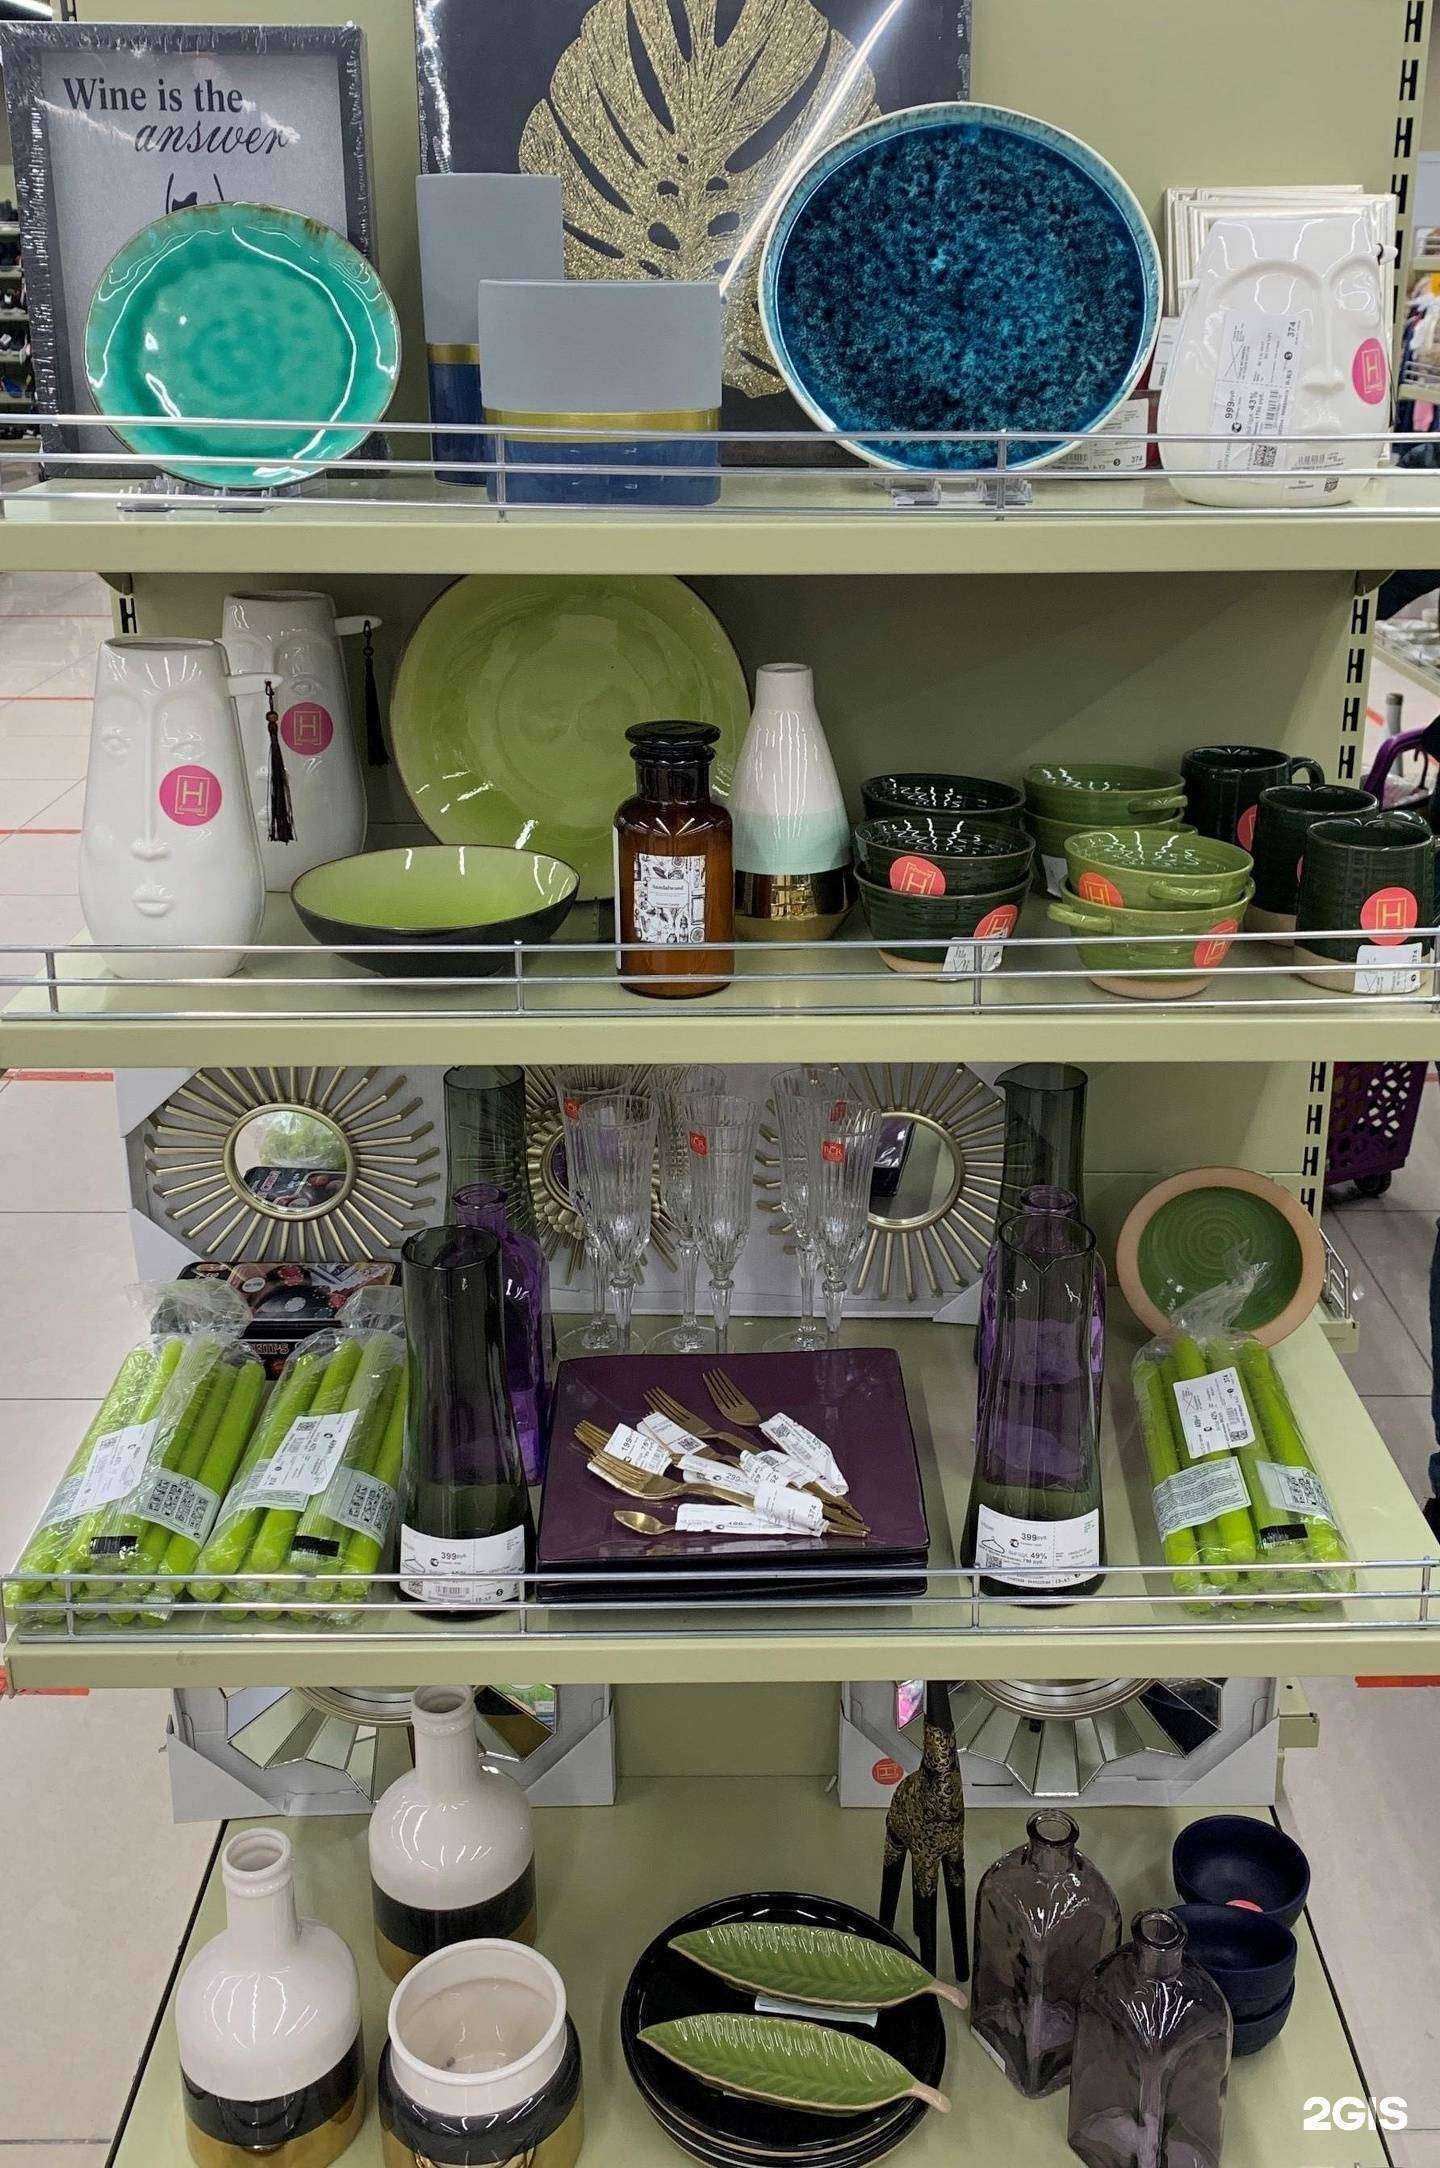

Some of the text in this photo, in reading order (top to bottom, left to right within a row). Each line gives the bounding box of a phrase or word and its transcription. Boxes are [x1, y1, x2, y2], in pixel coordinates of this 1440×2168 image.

[62, 78, 243, 112] Wine is the
[134, 120, 288, 155] answer
[1287, 321, 1296, 338] 374
